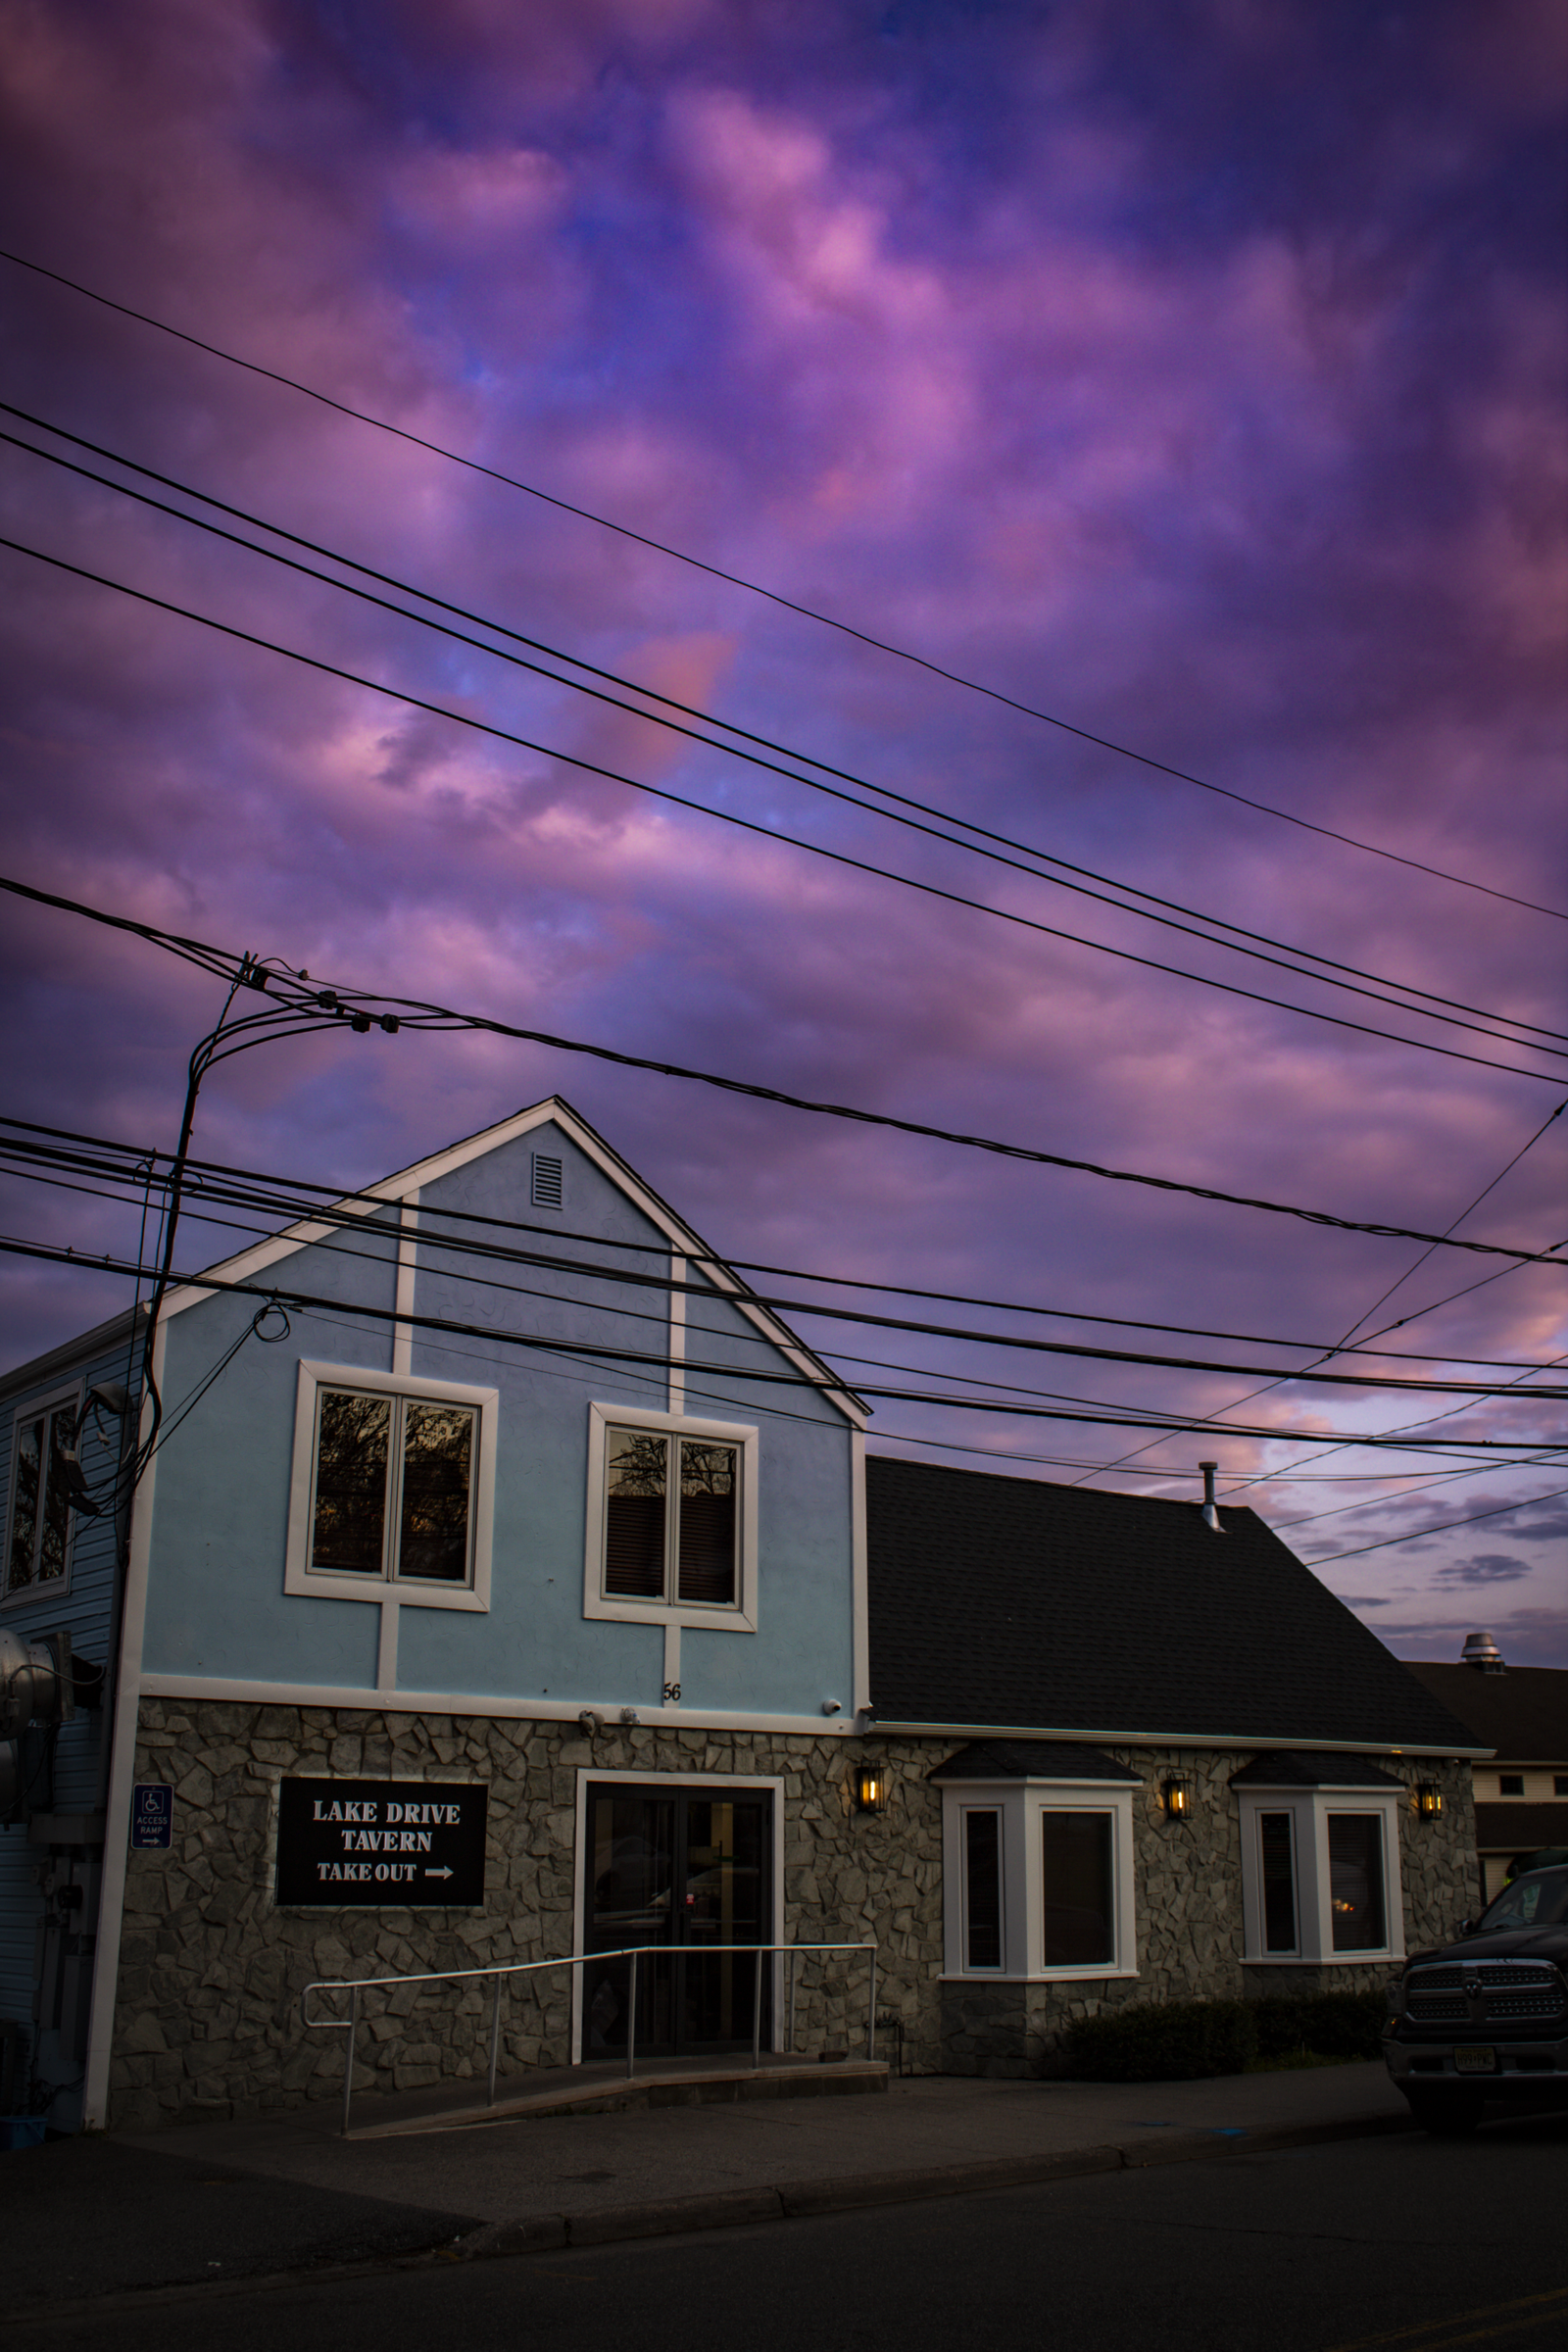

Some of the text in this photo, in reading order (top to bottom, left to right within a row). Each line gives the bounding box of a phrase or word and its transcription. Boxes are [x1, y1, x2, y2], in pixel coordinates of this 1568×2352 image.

[663, 1682, 681, 1701] 56
[136, 1816, 168, 1825] ACCESS
[313, 1800, 461, 1825] LAKE DRIVE
[140, 1826, 163, 1835] RAMP
[341, 1830, 433, 1851] TAVERN
[317, 1862, 416, 1882] TAKE OUT
